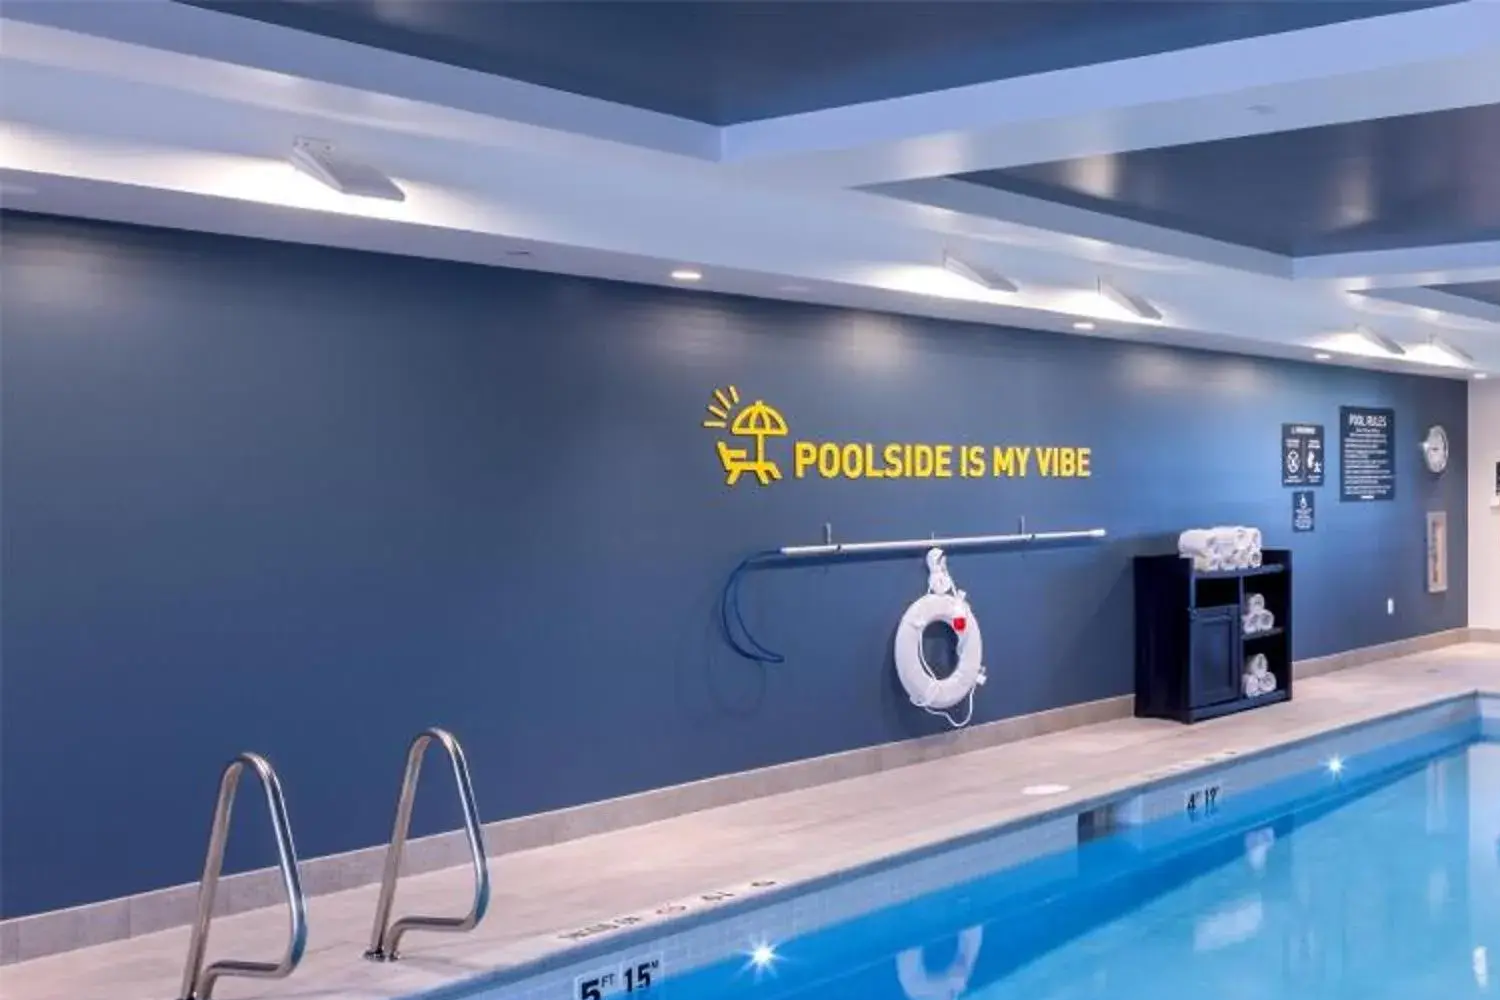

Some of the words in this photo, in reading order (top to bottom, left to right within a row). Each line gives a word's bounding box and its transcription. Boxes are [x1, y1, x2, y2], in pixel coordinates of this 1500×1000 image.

[795, 441, 953, 478] POOLSIDE
[959, 445, 986, 478] IS
[993, 447, 1029, 478] MY
[1036, 448, 1092, 478] VIBE
